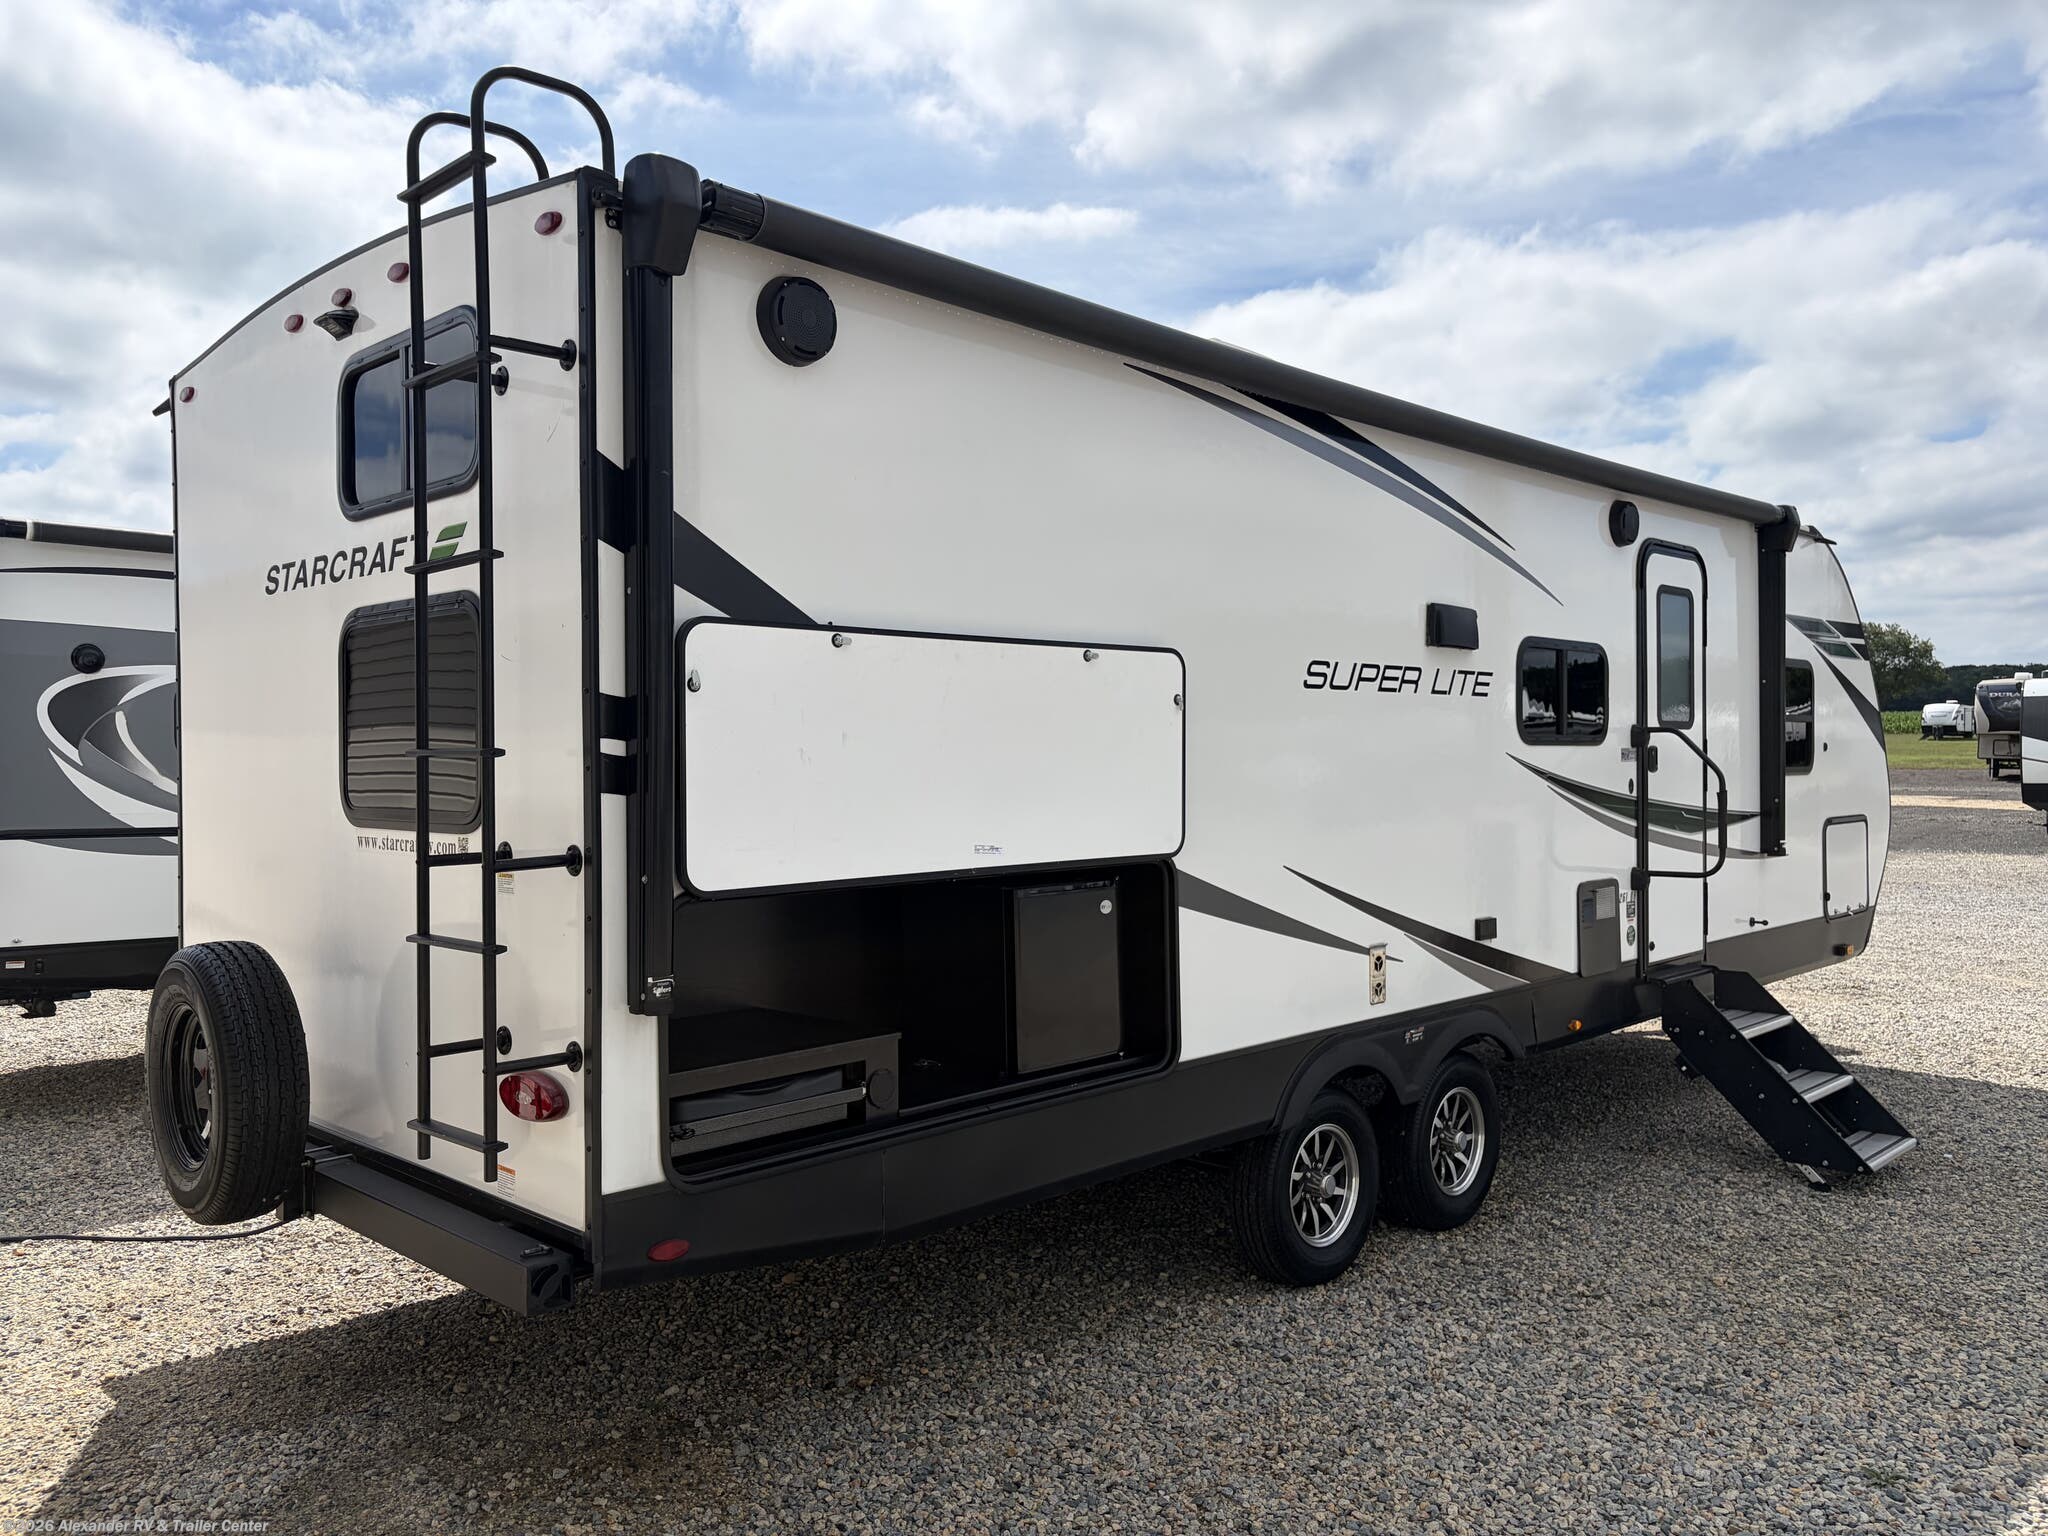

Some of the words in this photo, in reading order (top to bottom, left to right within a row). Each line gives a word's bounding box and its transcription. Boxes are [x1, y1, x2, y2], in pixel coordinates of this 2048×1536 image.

[265, 531, 428, 596] STARCRAF
[1303, 659, 1422, 694] SUPER
[1430, 668, 1494, 697] LITE
[357, 834, 457, 855] www.starcrav.com
